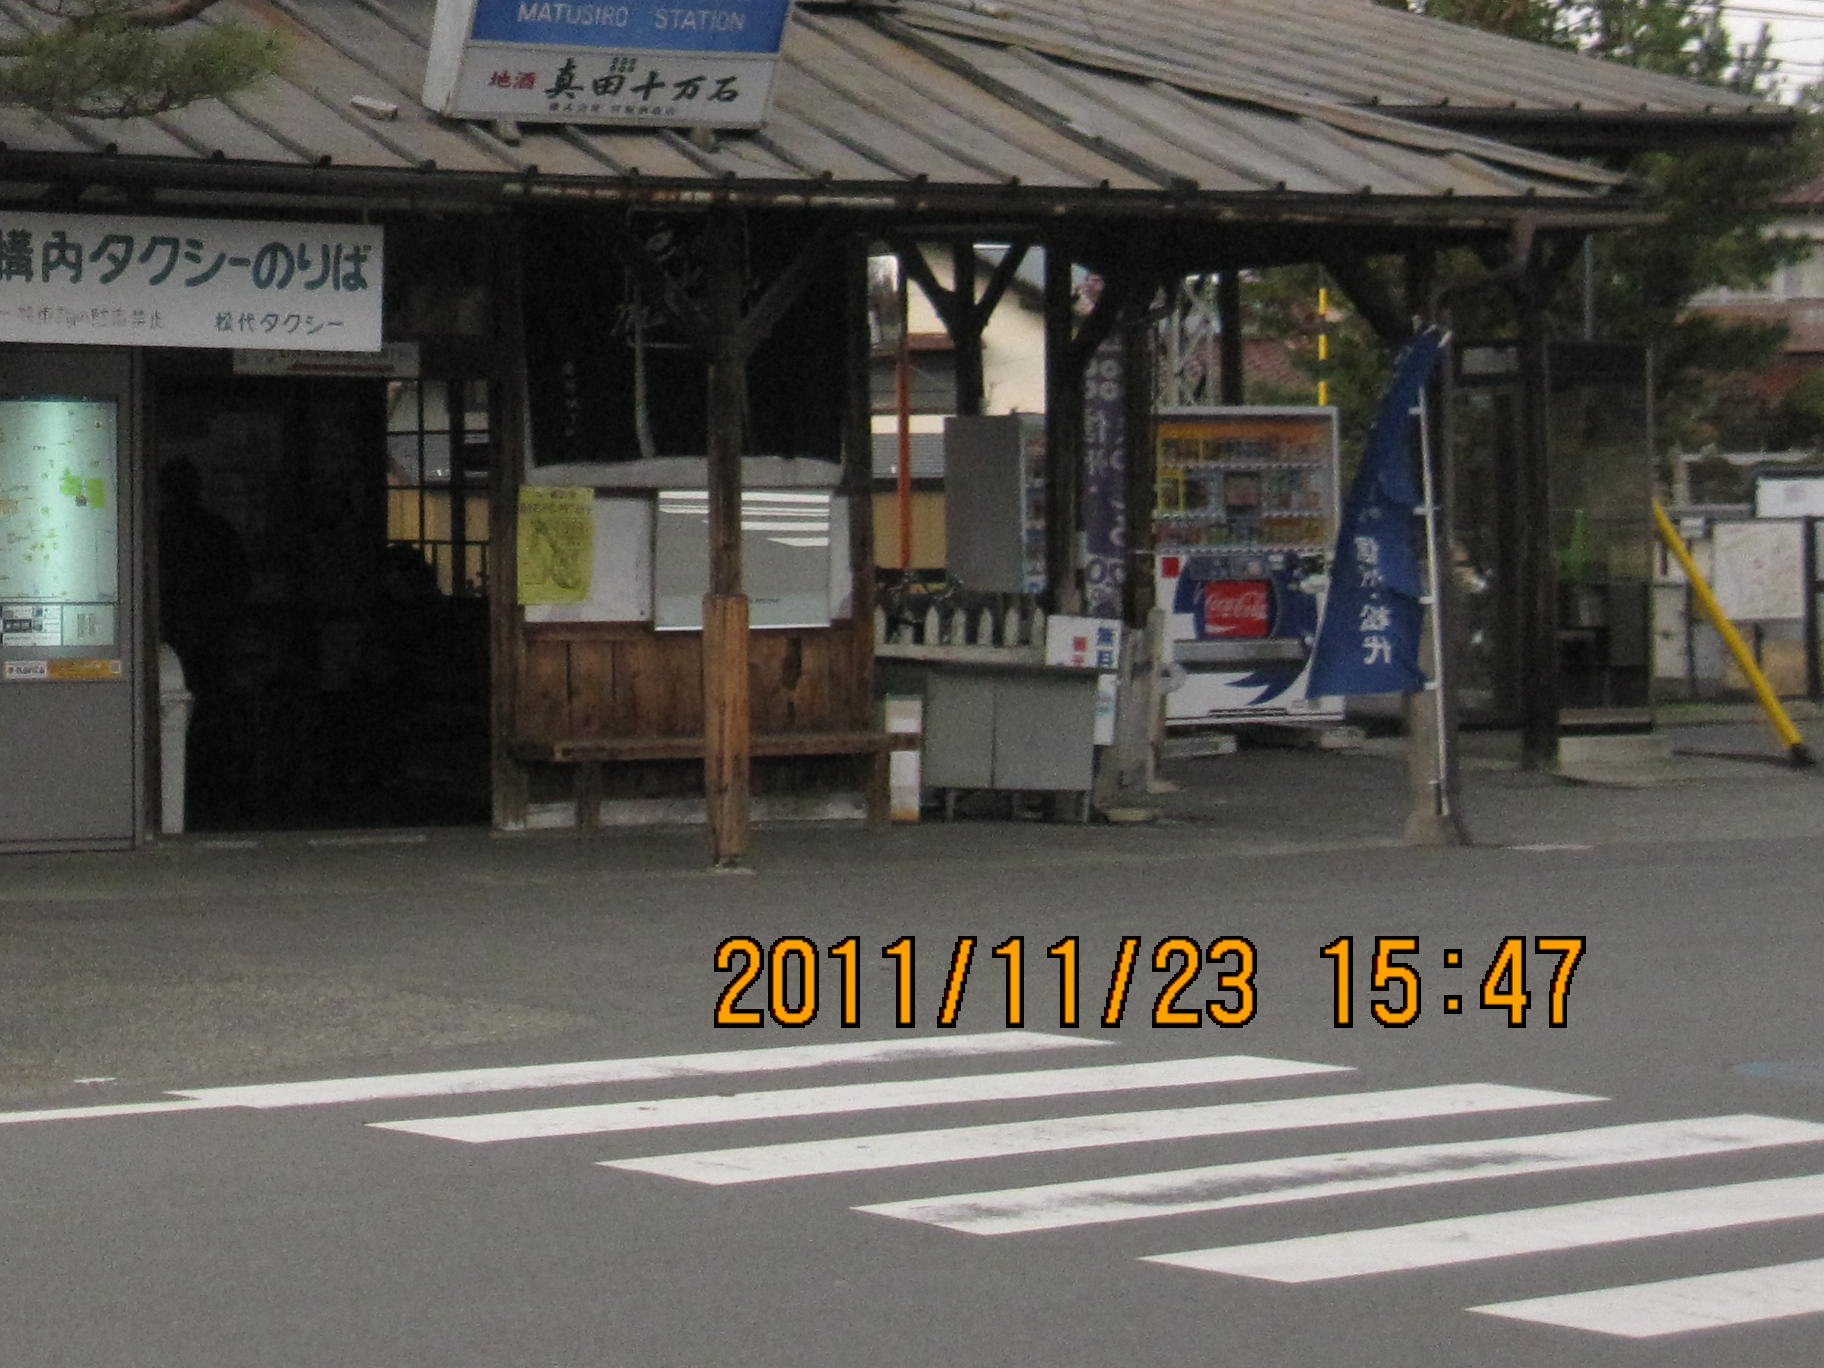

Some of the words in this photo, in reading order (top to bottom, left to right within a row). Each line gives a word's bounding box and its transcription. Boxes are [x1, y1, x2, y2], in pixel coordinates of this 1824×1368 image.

[517, 0, 629, 28] MATUSIRO
[653, 8, 747, 31] STATION
[488, 70, 537, 91] 地酒
[544, 57, 740, 103] 真田十万石
[214, 311, 346, 335] 松代タクシー
